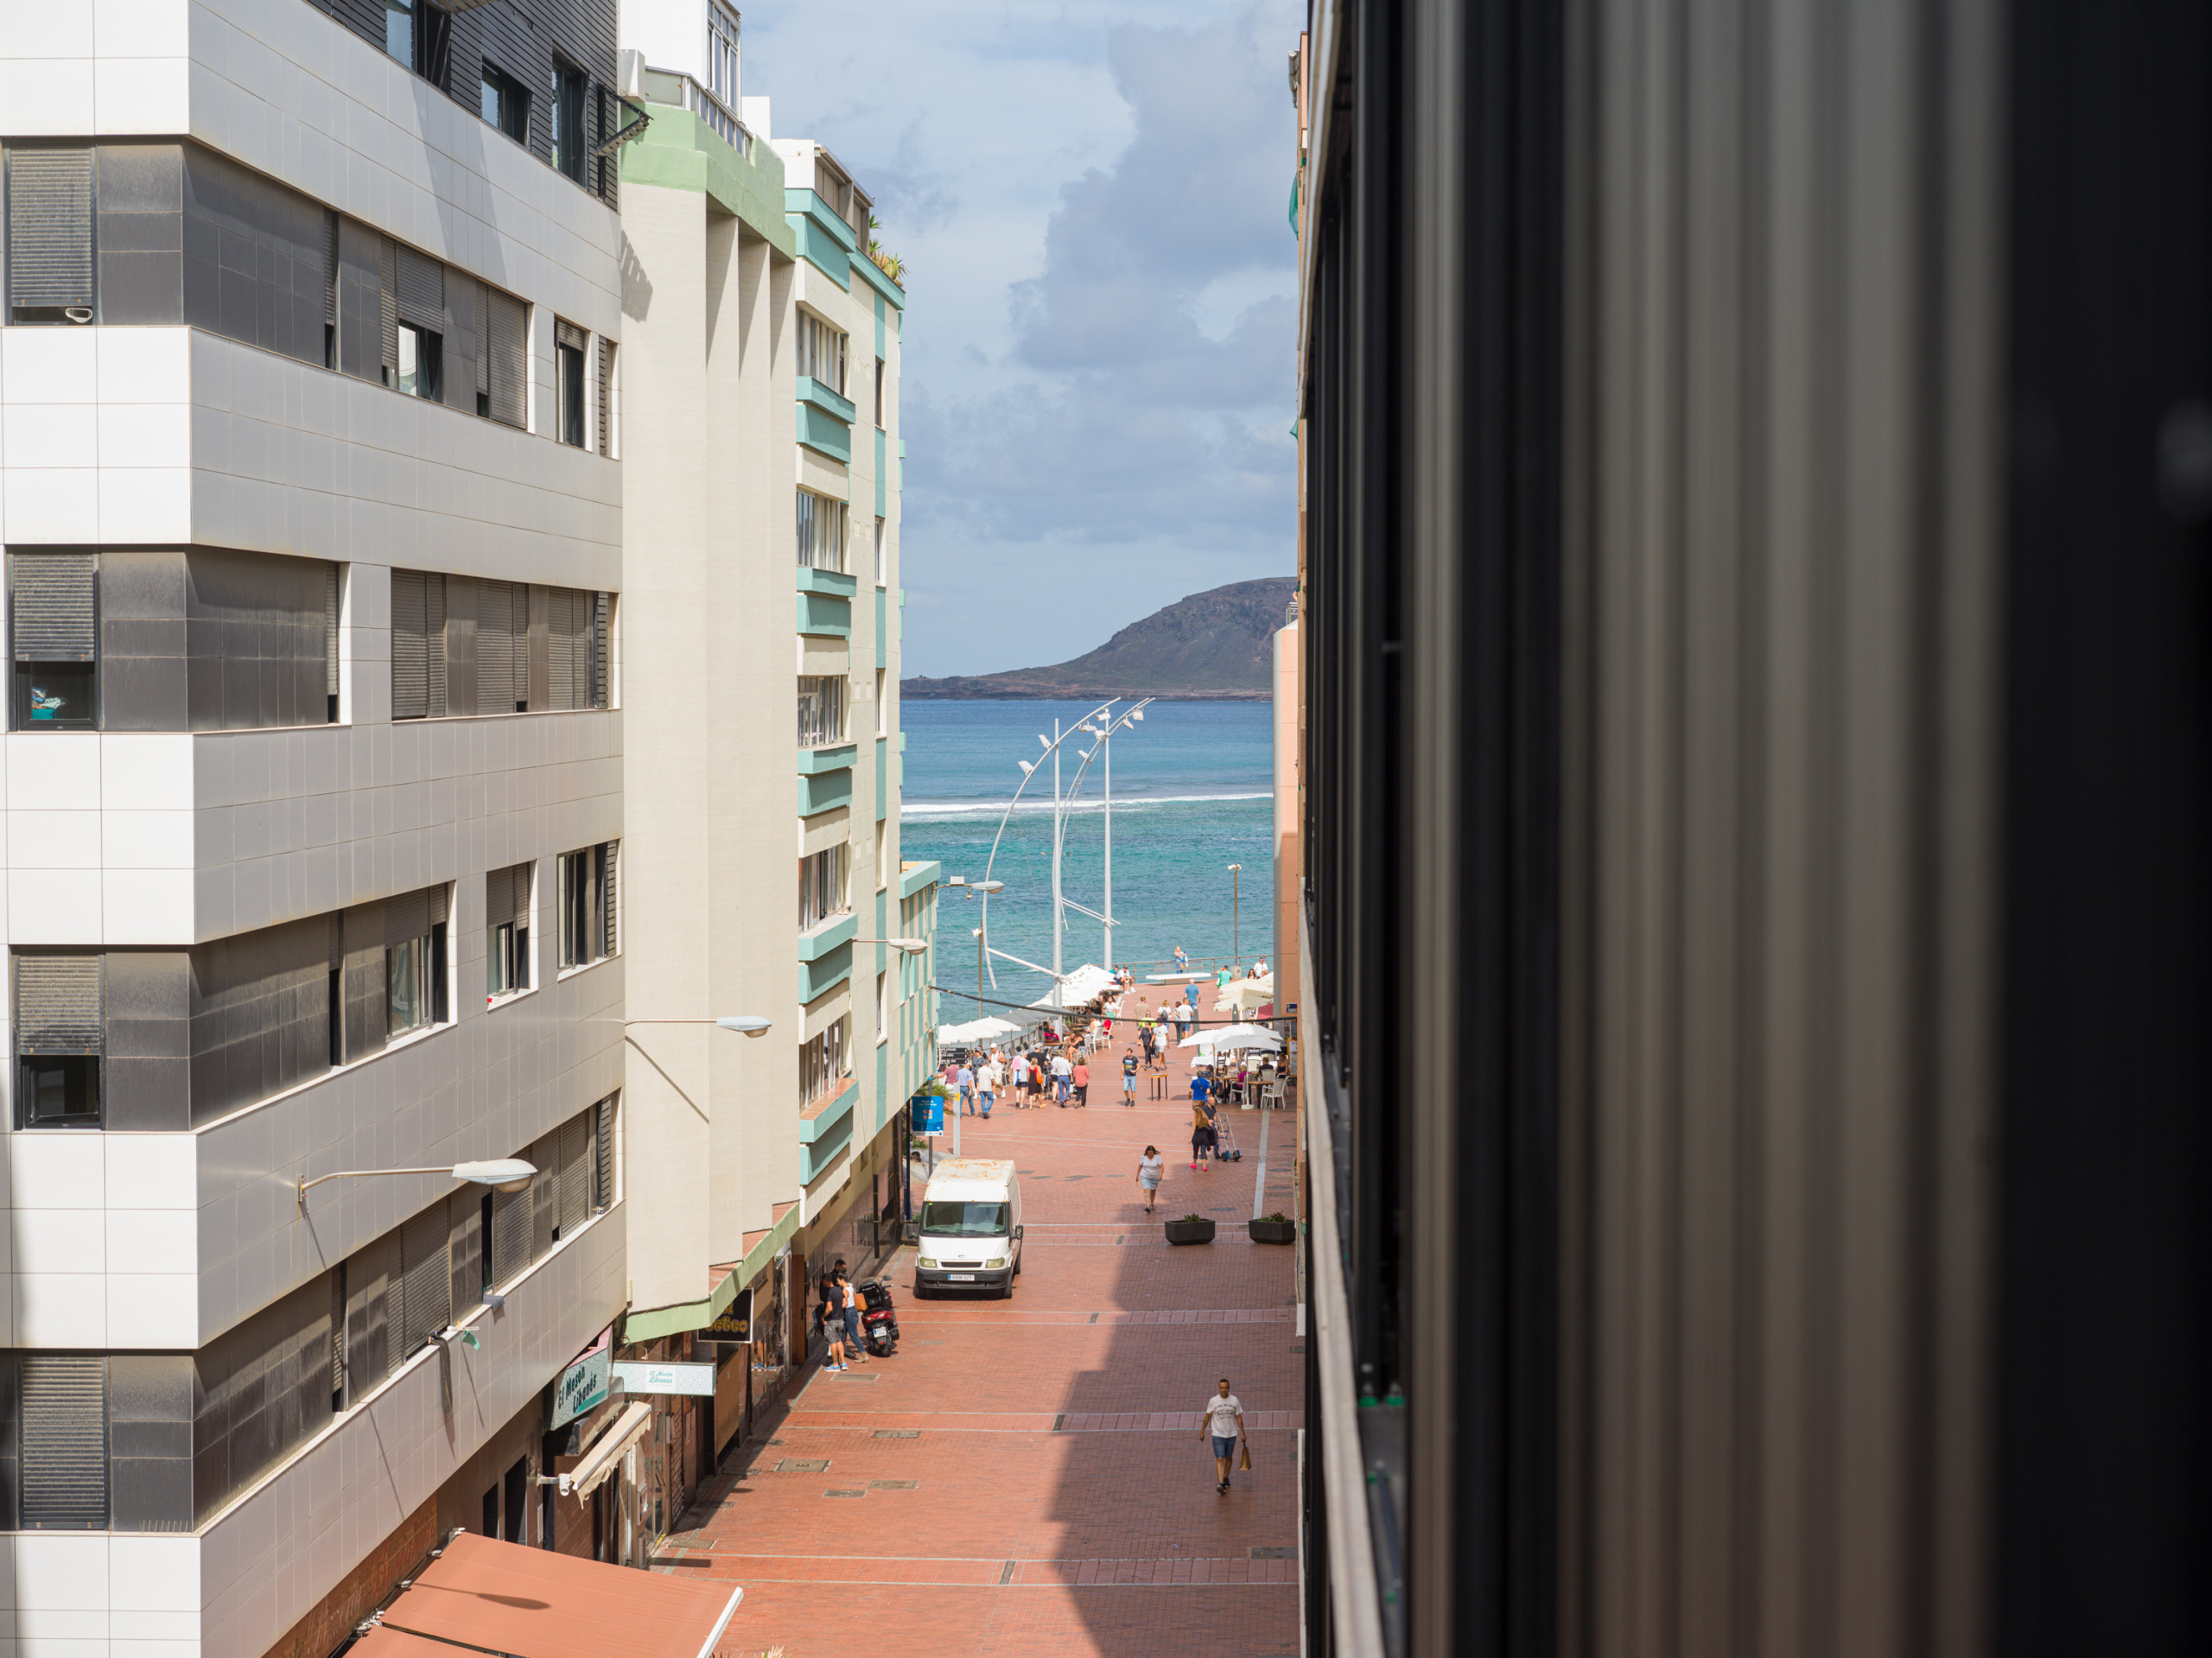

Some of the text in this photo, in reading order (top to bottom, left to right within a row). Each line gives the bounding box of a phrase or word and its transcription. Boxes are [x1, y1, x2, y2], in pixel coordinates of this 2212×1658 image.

[558, 1364, 585, 1410] El Mesón
[573, 1369, 596, 1414] Libanés
